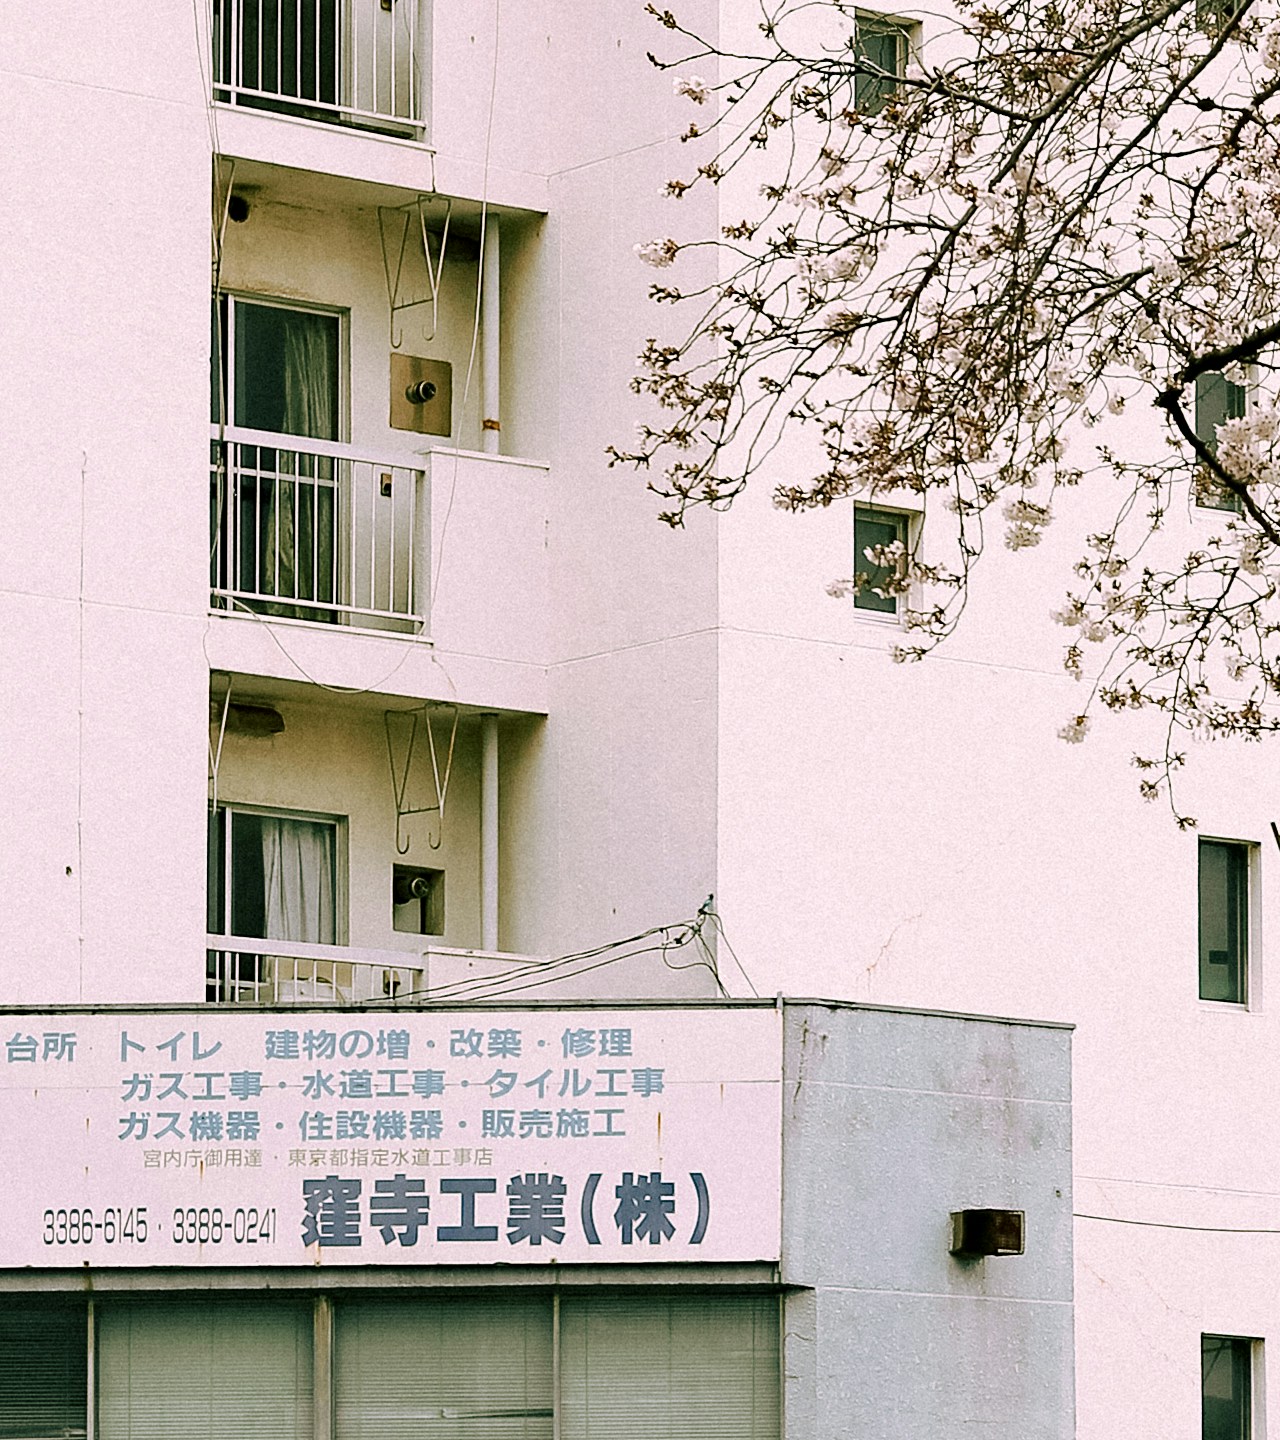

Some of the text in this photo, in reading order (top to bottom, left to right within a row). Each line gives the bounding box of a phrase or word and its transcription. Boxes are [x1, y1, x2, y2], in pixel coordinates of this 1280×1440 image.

[5, 1028, 633, 1062] 台所 トイレ 建物の増・改築・修理
[121, 1067, 665, 1101] ガス工事・水道工事・タイル工事
[118, 1107, 626, 1141] ガス機器・住設機器・販売施工
[301, 1172, 710, 1247] 窪寺工業(株)
